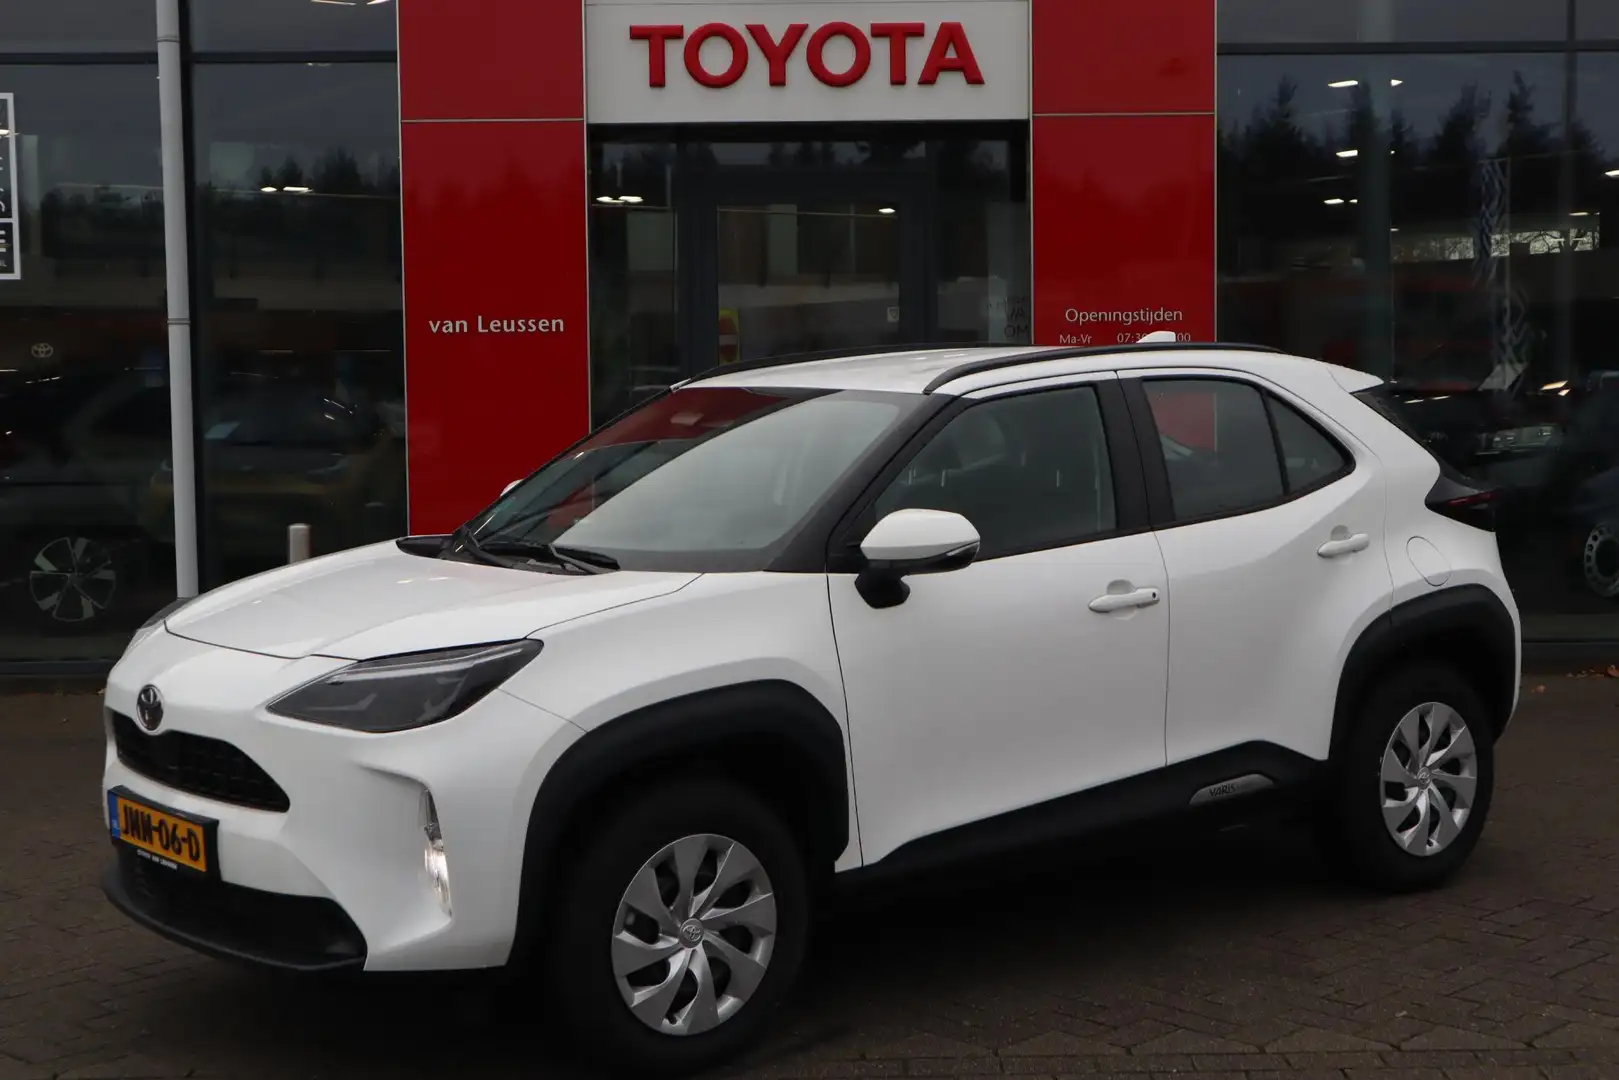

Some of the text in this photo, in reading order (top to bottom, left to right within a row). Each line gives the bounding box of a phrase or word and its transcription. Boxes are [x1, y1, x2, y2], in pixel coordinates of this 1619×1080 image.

[629, 21, 985, 88] TOYOTA
[429, 315, 564, 333] van Leussen
[1065, 307, 1183, 326] Openingstijden
[1059, 333, 1093, 344] Ma-Vr
